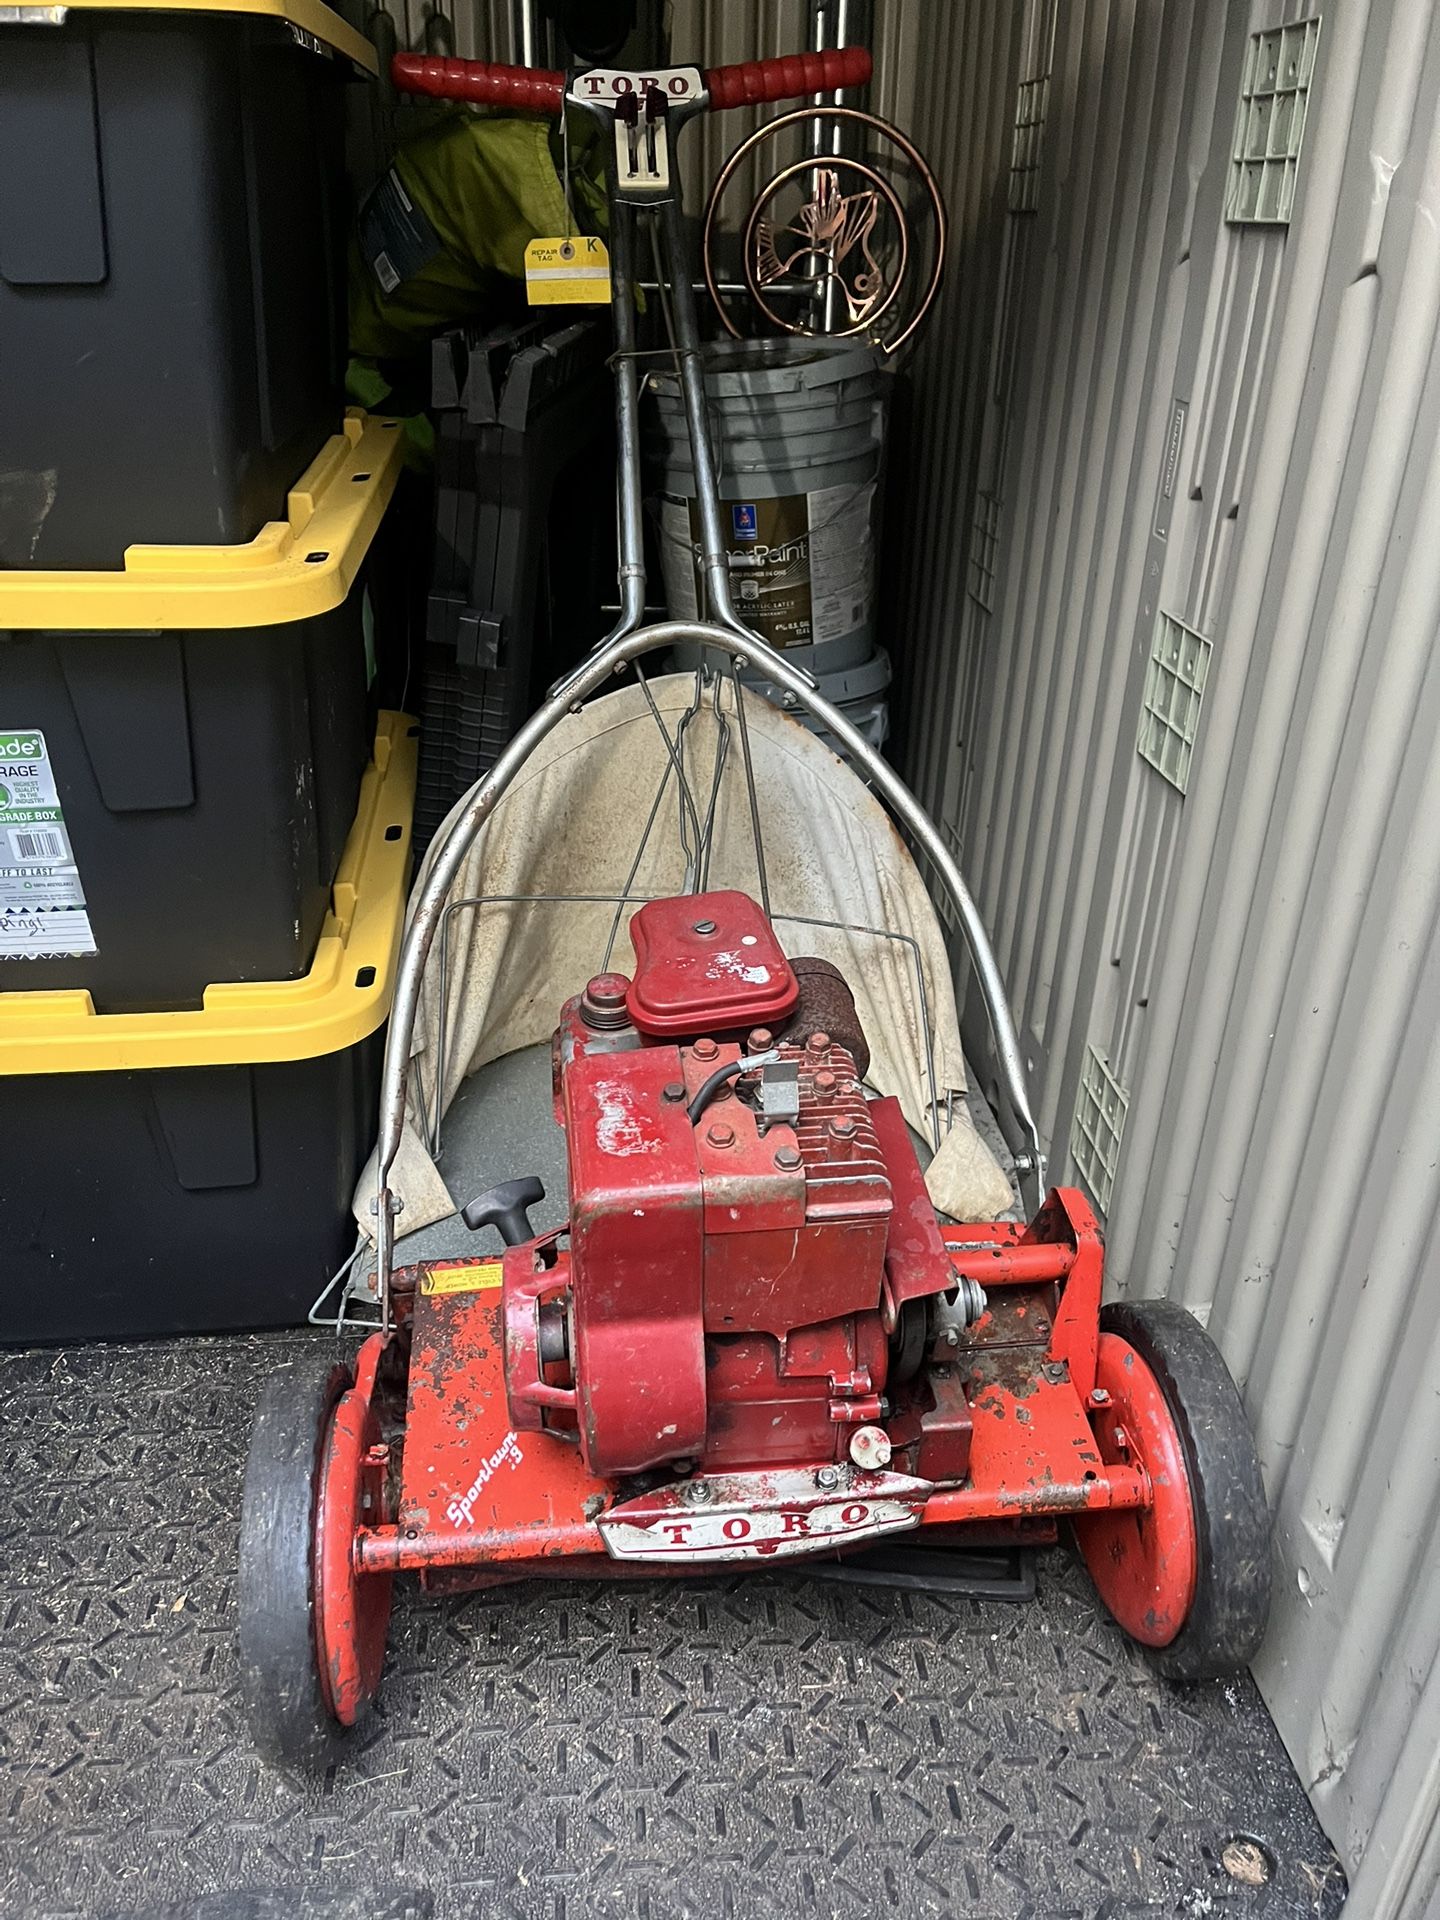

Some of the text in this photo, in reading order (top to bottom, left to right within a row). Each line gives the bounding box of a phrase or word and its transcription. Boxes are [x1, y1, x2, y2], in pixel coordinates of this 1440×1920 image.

[584, 76, 690, 96] TORO
[586, 238, 598, 252] K
[35, 811, 58, 820] BOX
[16, 868, 27, 876] TO
[31, 867, 54, 876] LAST
[446, 1431, 518, 1529] Sportlawn
[662, 1504, 869, 1544] TORO
